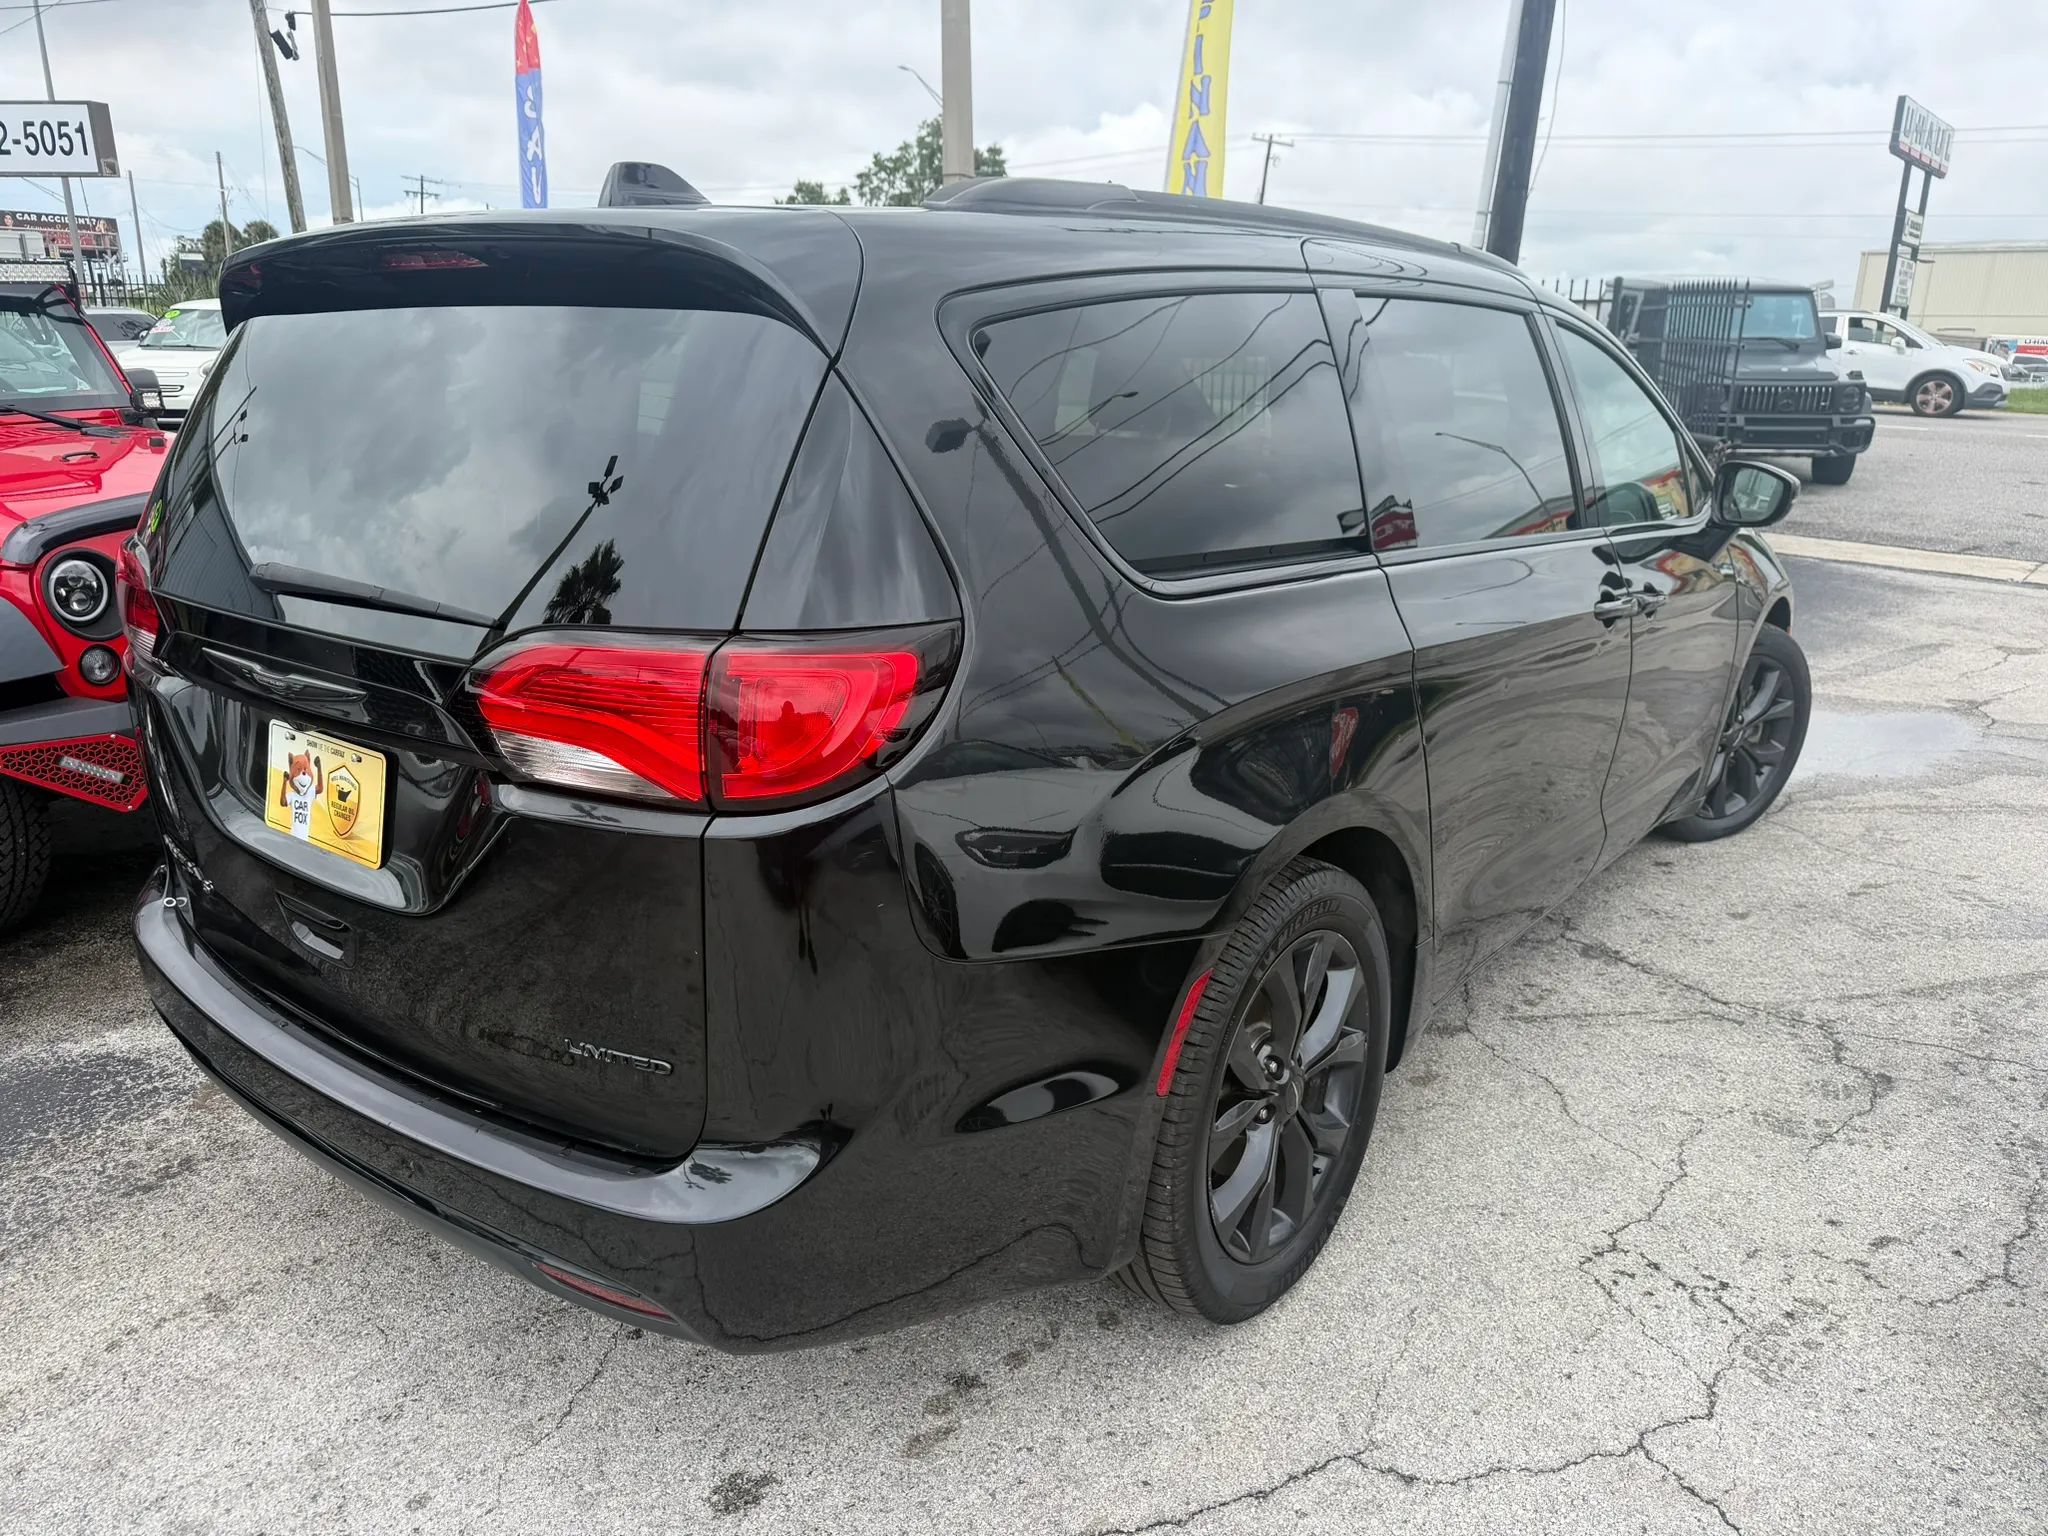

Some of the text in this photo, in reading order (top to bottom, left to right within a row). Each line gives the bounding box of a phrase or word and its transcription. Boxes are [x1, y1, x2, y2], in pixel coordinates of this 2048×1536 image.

[1182, 0, 1212, 197] INAN
[0, 119, 88, 157] 2-5051
[16, 213, 97, 226] CAR ACCINT?
[294, 799, 308, 812] CAR
[294, 811, 308, 825] FOX
[564, 1038, 672, 1076] LIMITED
